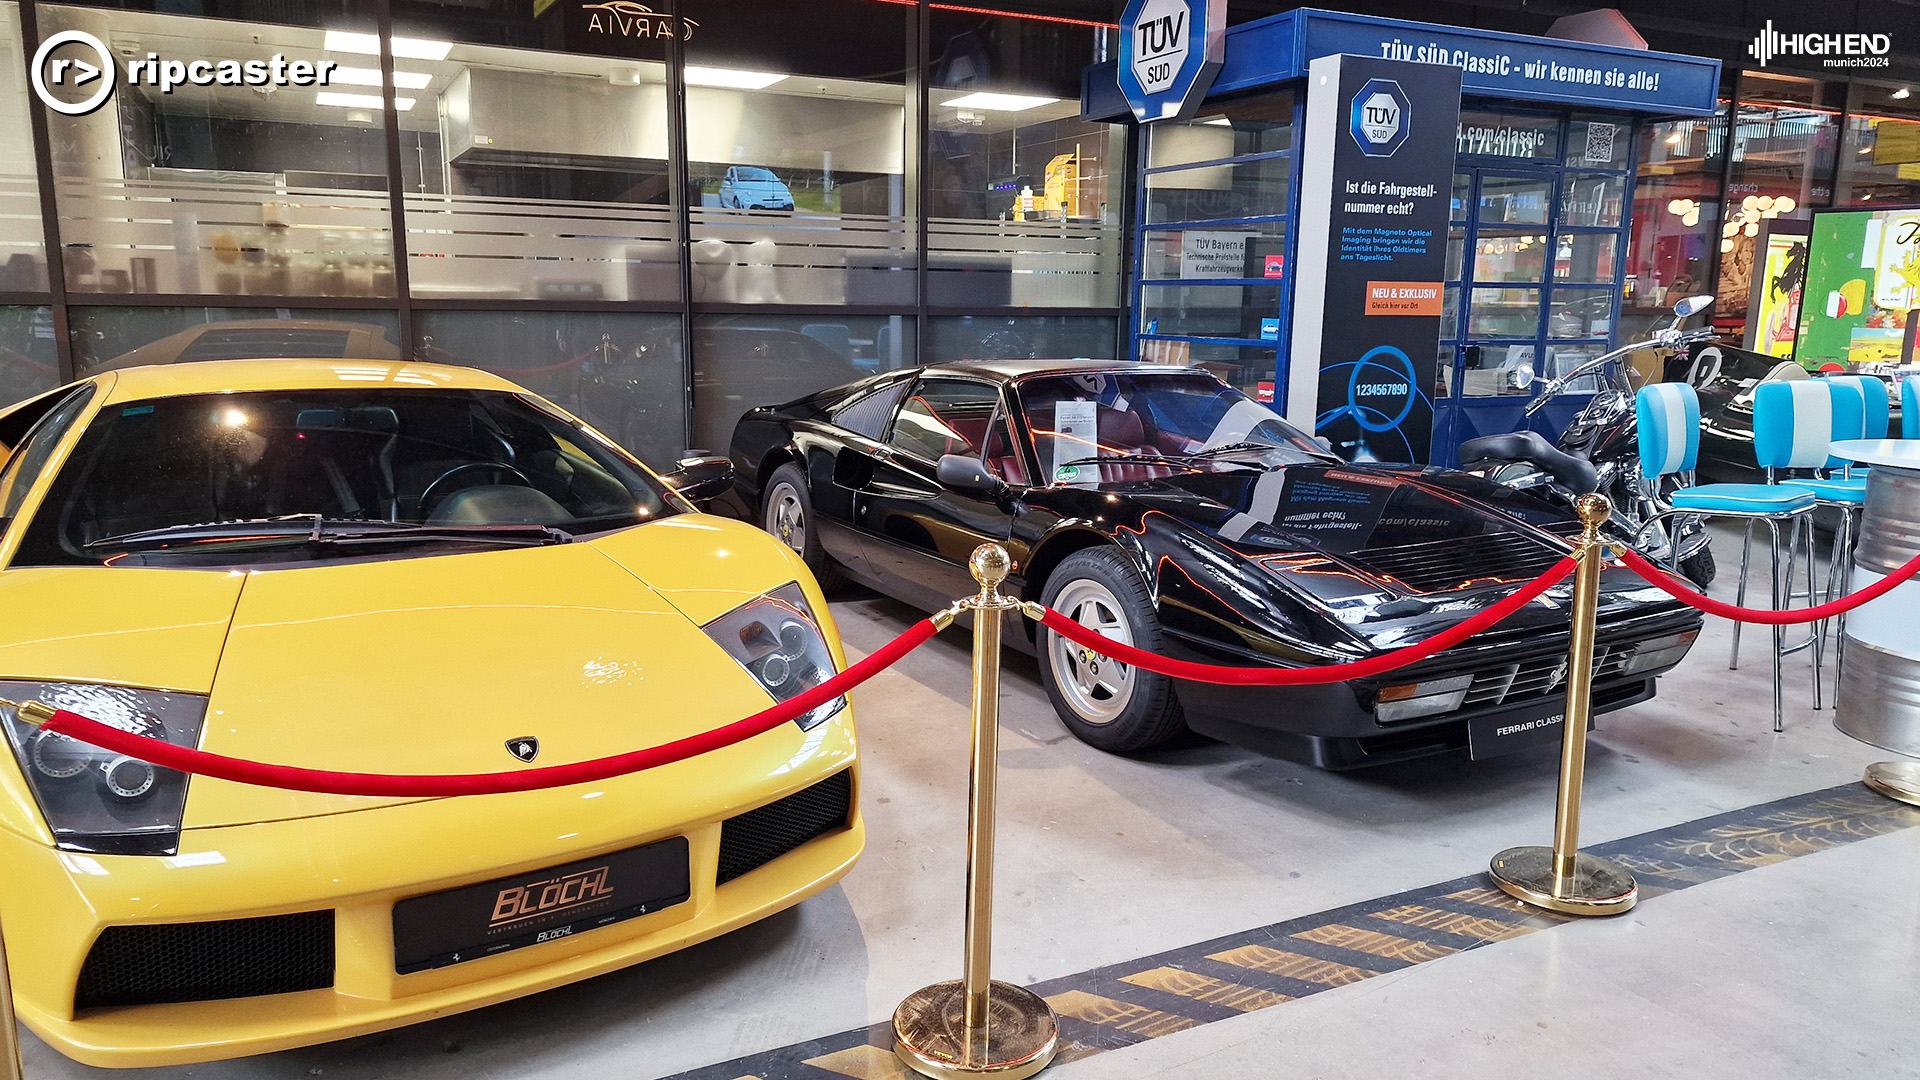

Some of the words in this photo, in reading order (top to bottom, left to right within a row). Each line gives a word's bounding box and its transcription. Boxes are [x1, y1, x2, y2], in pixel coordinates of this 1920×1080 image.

[1138, 11, 1185, 56] TÜV
[1381, 38, 1414, 60] TÜV
[1524, 59, 1548, 80] wir
[1550, 61, 1601, 85] kennen
[1604, 67, 1625, 88] sie
[1628, 70, 1660, 91] alle!
[1147, 62, 1170, 84] SÜD
[1366, 106, 1397, 124] TÜV
[1372, 129, 1388, 139] SÜD
[1345, 180, 1359, 194] Ist
[1361, 180, 1377, 195] die
[1379, 181, 1438, 199] Fahrgestell-
[1344, 202, 1387, 214] nummer
[1387, 201, 1415, 215] echt?
[1357, 227, 1373, 235] dem
[1374, 228, 1406, 237] Magneto
[1407, 229, 1433, 237] Optical
[1195, 237, 1210, 249] TÜV
[1212, 239, 1238, 251] Bayern
[1341, 235, 1371, 245] Imaging
[1372, 237, 1400, 246] bringen
[1414, 237, 1426, 245] die
[1341, 244, 1372, 252] Identität
[1392, 246, 1427, 254] Oldtimers
[1186, 252, 1214, 261] Technische
[1372, 287, 1390, 299] NEU
[1390, 288, 1398, 299] &
[1399, 288, 1438, 299] EXKLUSIV
[1371, 301, 1389, 309] Gleich
[1355, 383, 1408, 396] 1234567890
[1496, 721, 1535, 737] FERRARI
[490, 865, 614, 922] BLÖCHL
